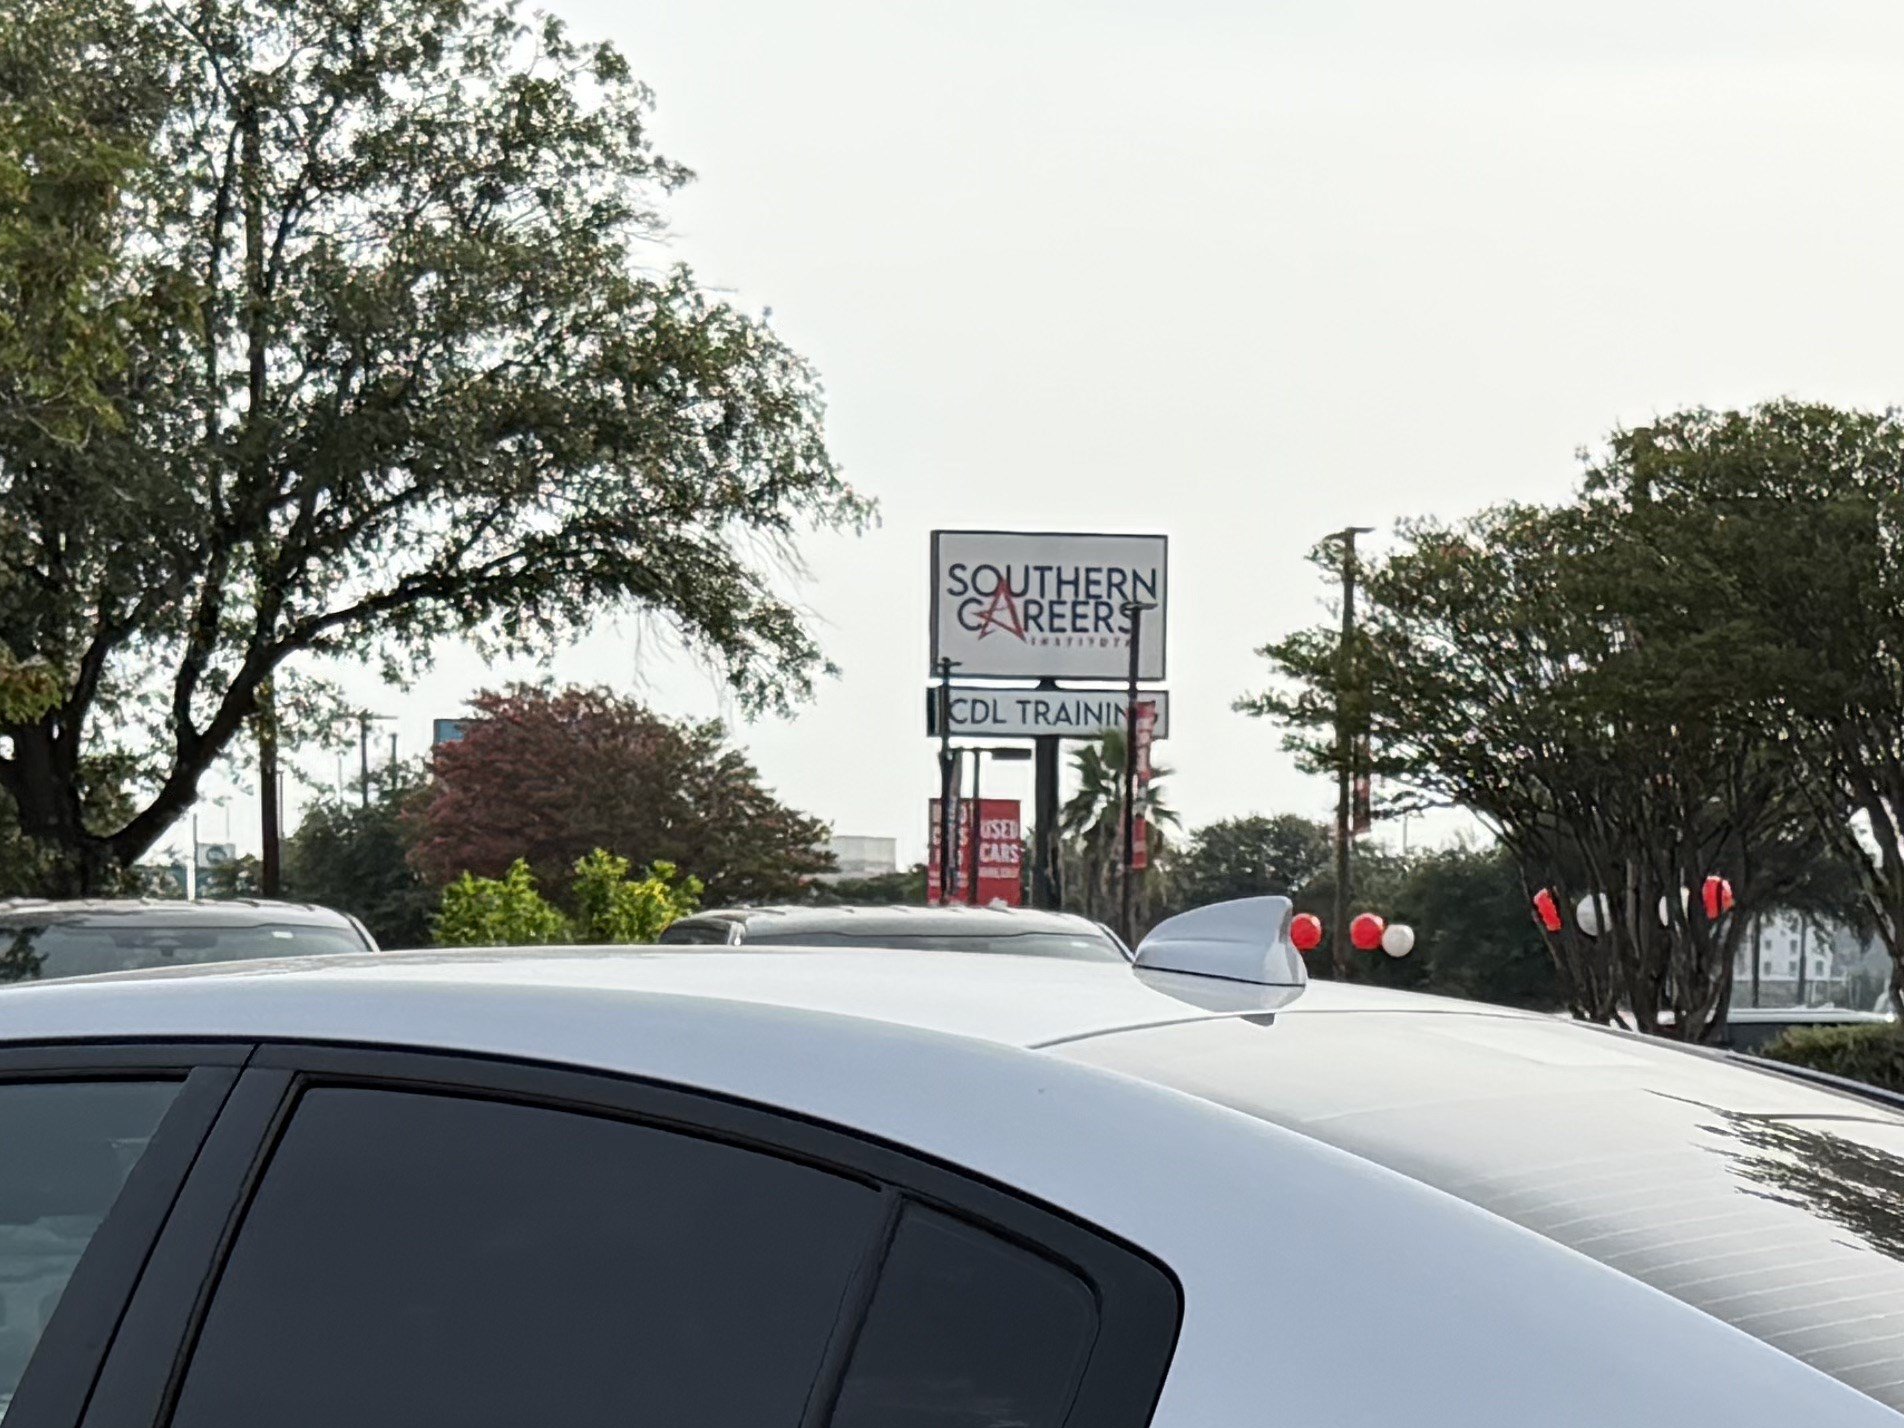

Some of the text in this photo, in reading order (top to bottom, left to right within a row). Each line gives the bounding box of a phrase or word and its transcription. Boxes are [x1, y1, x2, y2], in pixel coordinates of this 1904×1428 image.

[945, 562, 1158, 601] SOUTHERN
[956, 582, 1134, 640] CAREERS
[948, 698, 1158, 727] CDL TRAININ
[979, 842, 1019, 863] CARS
